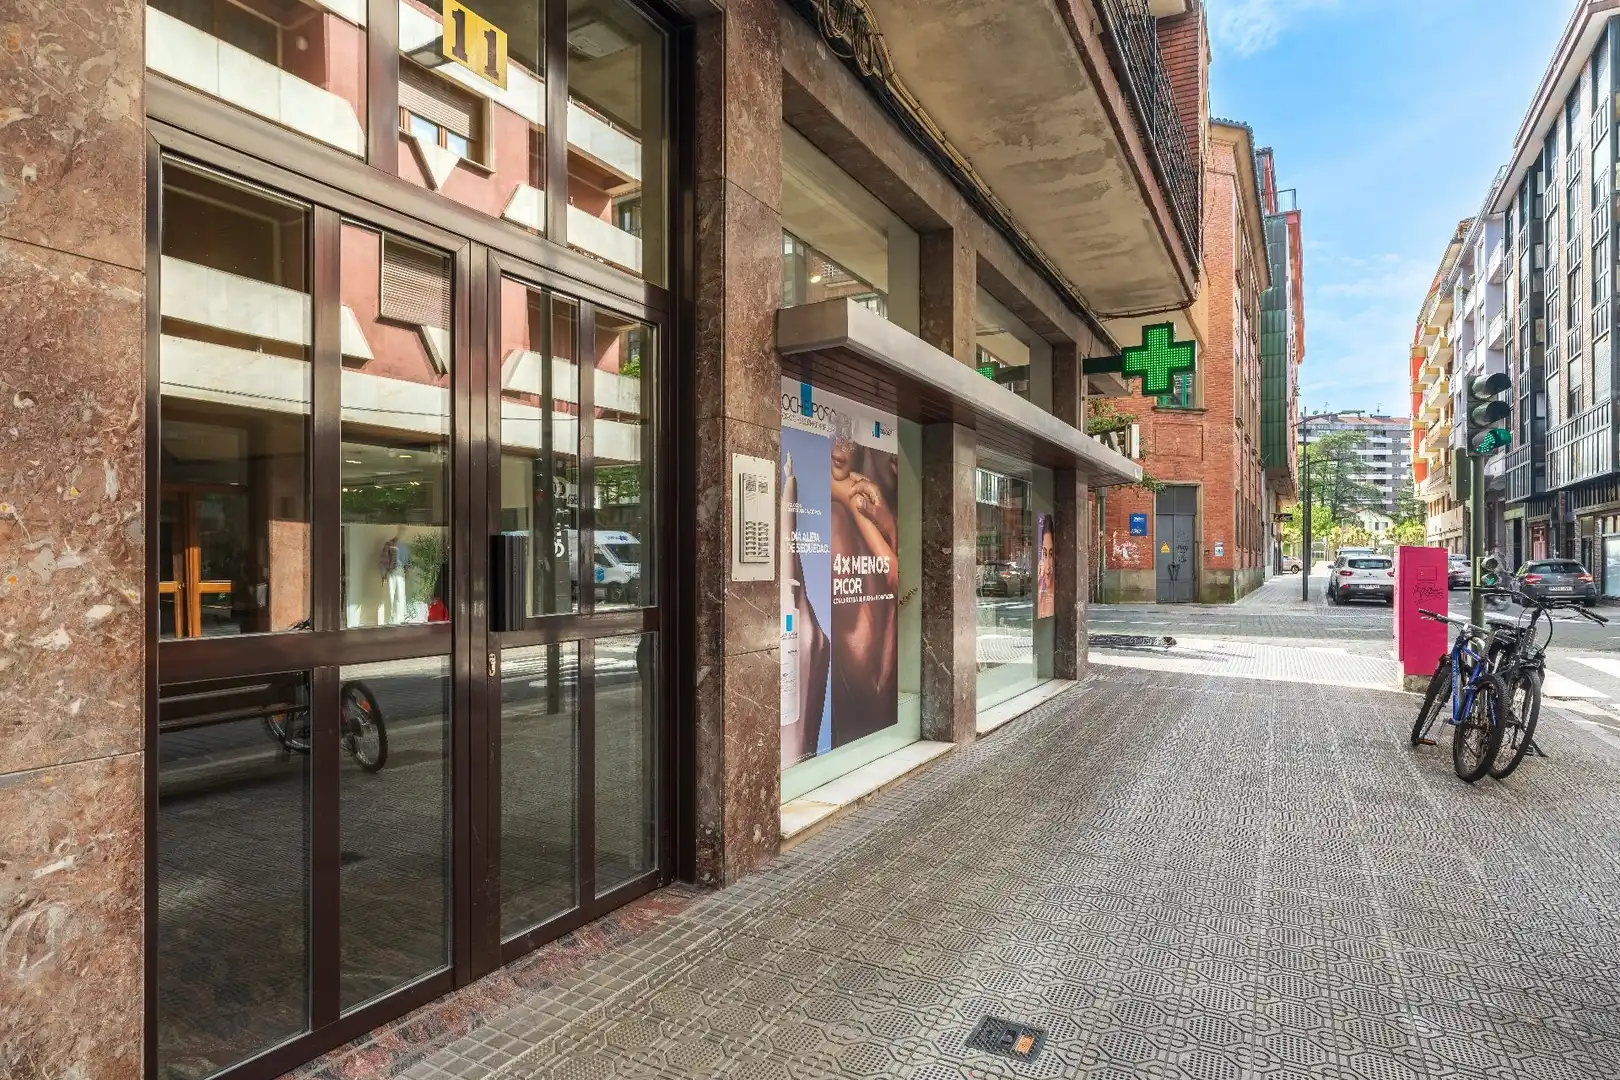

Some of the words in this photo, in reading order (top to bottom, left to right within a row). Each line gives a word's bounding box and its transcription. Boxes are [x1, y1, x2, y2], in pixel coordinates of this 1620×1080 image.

[452, 8, 500, 81] 11
[852, 555, 890, 575] MENOS
[833, 578, 863, 595] PICOR
